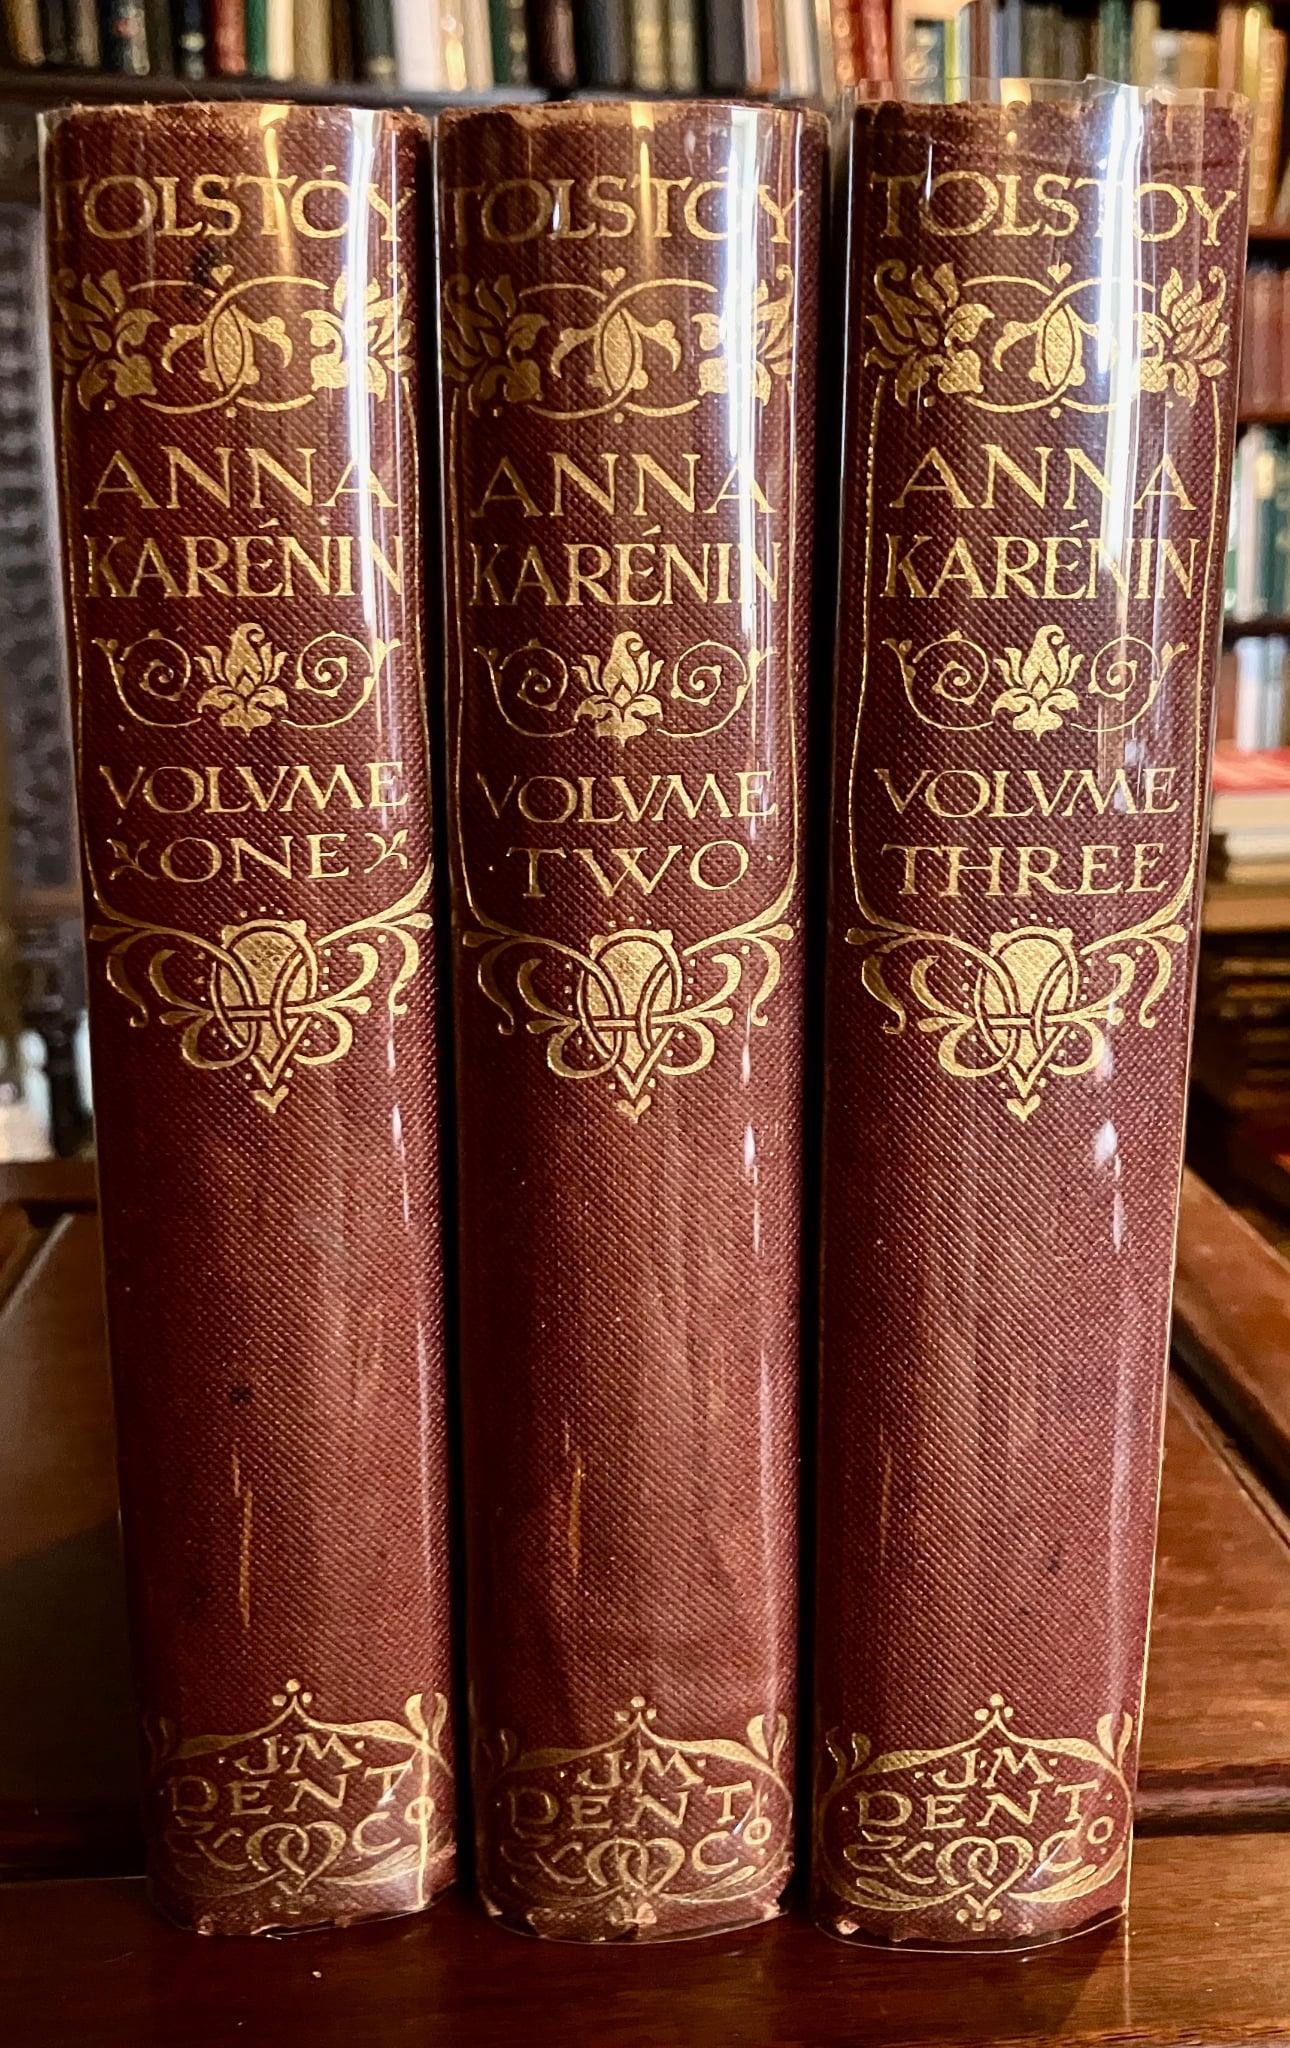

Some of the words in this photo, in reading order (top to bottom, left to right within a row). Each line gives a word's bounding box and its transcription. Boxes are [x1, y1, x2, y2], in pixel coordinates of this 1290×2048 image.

[83, 446, 398, 510] ANNA
[469, 453, 777, 517] ANNA
[889, 444, 1197, 511] ANNA
[83, 517, 404, 599] KARÉNIN
[468, 525, 781, 607] KARÉNIN
[880, 518, 1201, 600] KARÉNIN
[160, 832, 349, 883] ONE
[506, 840, 750, 898] TWO
[881, 842, 1167, 898] THREE
[171, 1757, 413, 1816] DENT
[509, 1780, 753, 1830] DENT
[856, 1778, 1100, 1830] DENT
